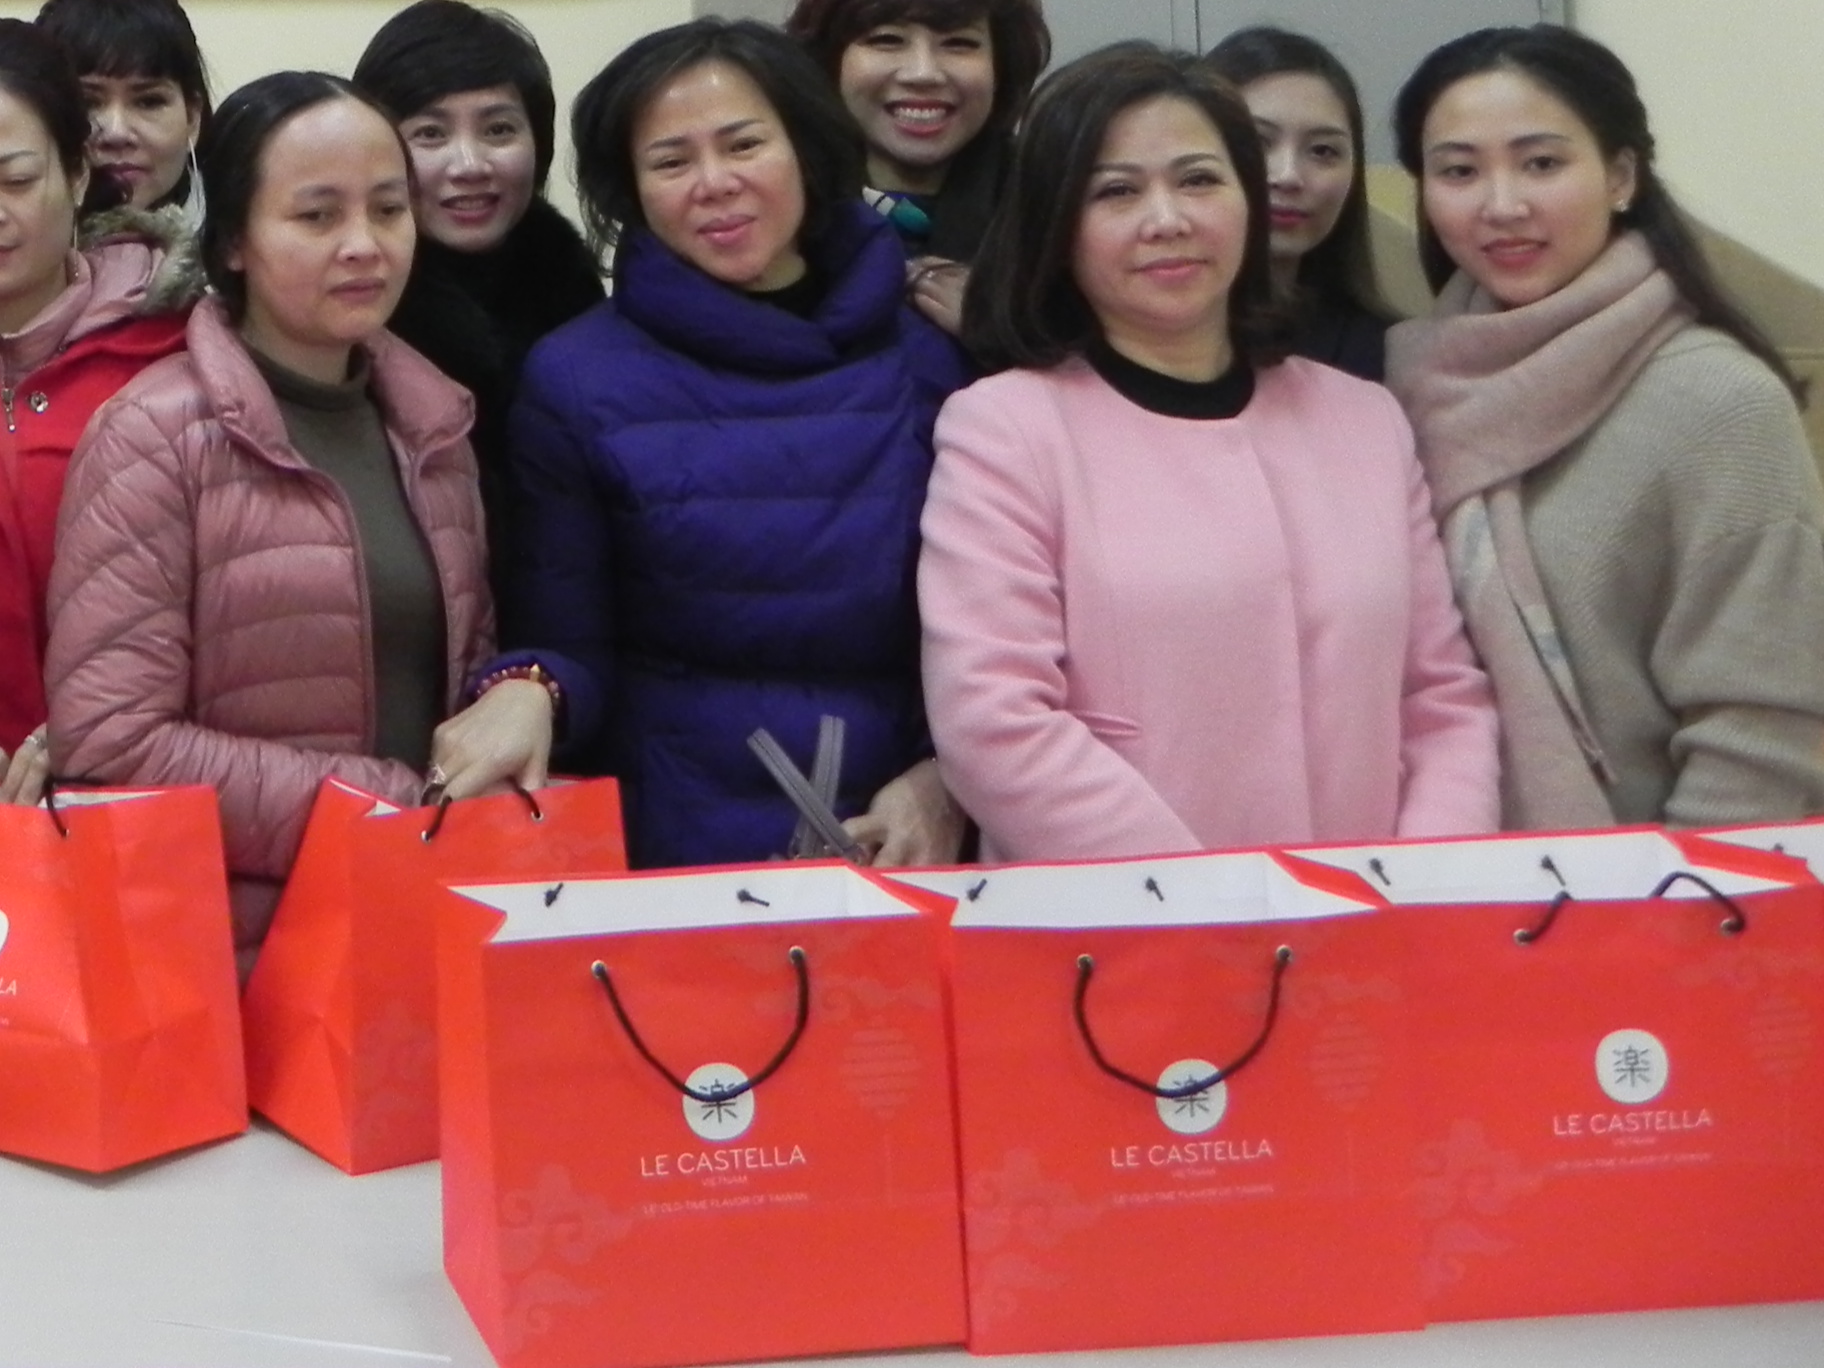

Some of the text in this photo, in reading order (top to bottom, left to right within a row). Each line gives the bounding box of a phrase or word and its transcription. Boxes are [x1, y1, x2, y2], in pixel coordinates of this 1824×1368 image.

[1552, 1107, 1714, 1136] LE CASTELLA
[639, 1144, 807, 1178] LE CASTELLA
[1110, 1138, 1274, 1168] LE CASTELLA
